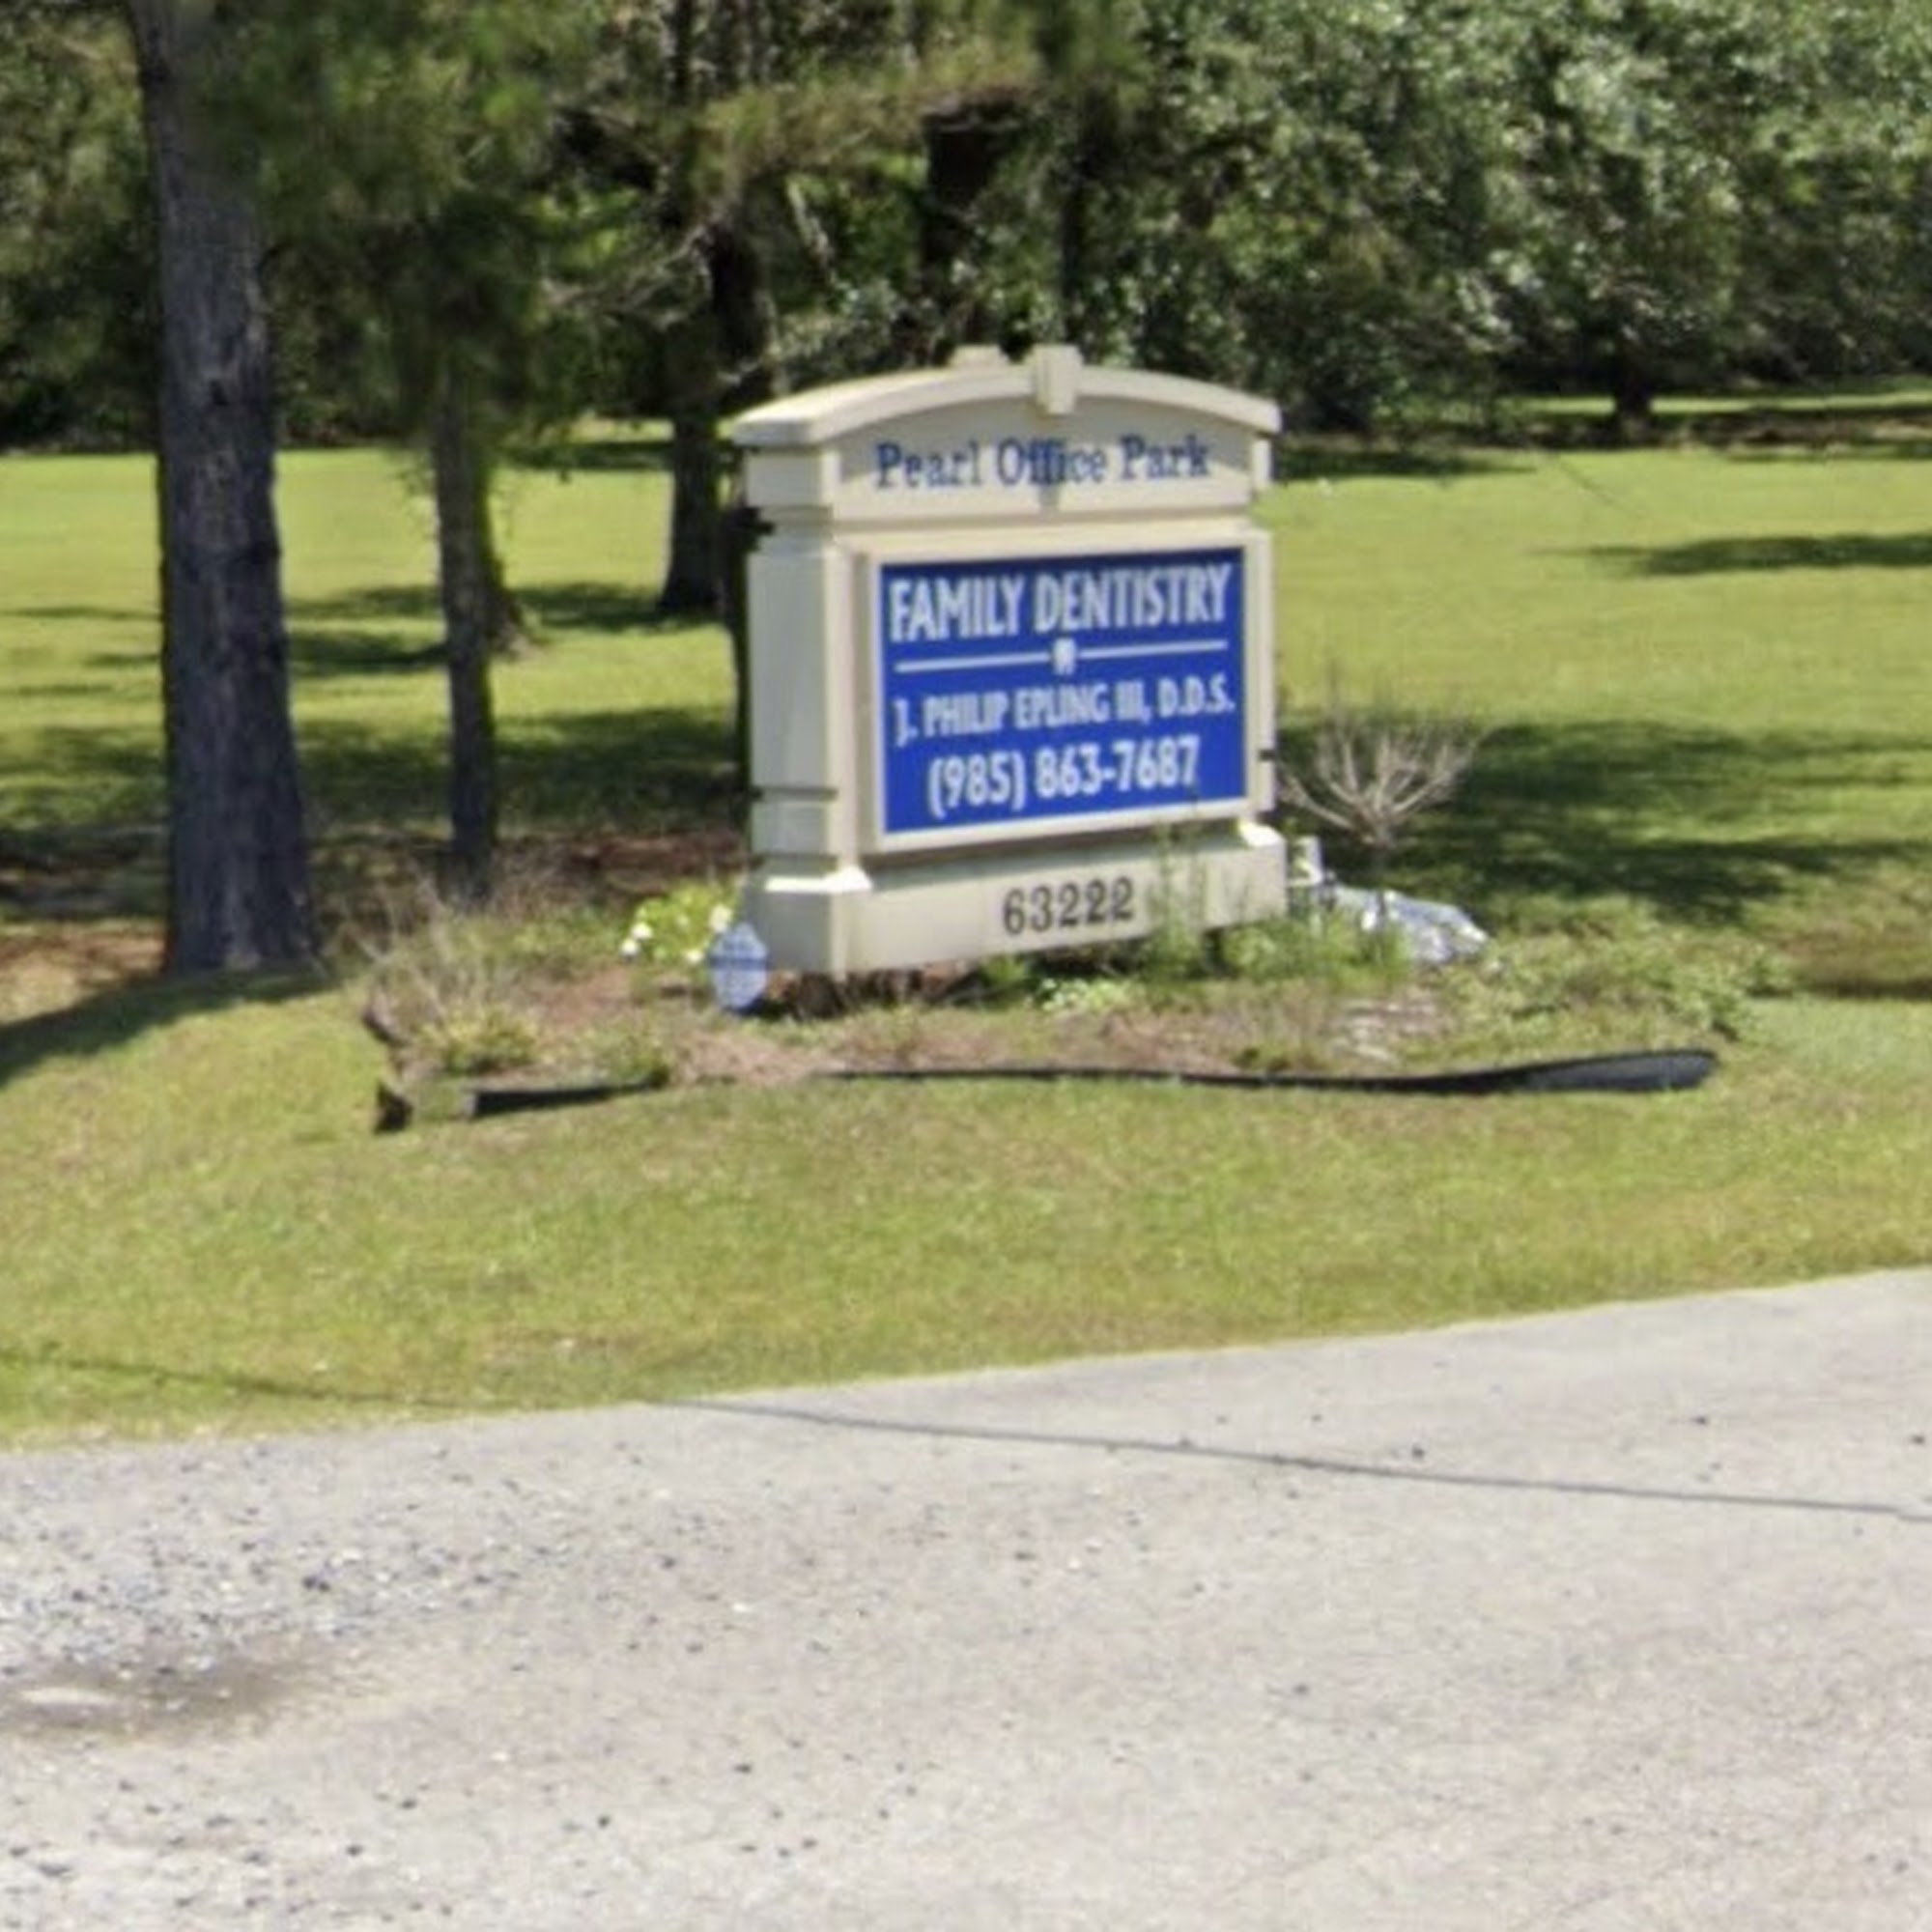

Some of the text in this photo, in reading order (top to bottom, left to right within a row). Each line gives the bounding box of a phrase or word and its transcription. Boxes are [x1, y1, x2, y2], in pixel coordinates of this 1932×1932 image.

[875, 433, 1210, 489] Pearl Office Park
[889, 562, 1232, 643] FAMILY DENTISTRY
[894, 674, 1236, 748] J. PHILIP EPLING III, D.D.S.
[928, 734, 1200, 819] (985) 863-7687
[1003, 876, 1134, 935] 63222
